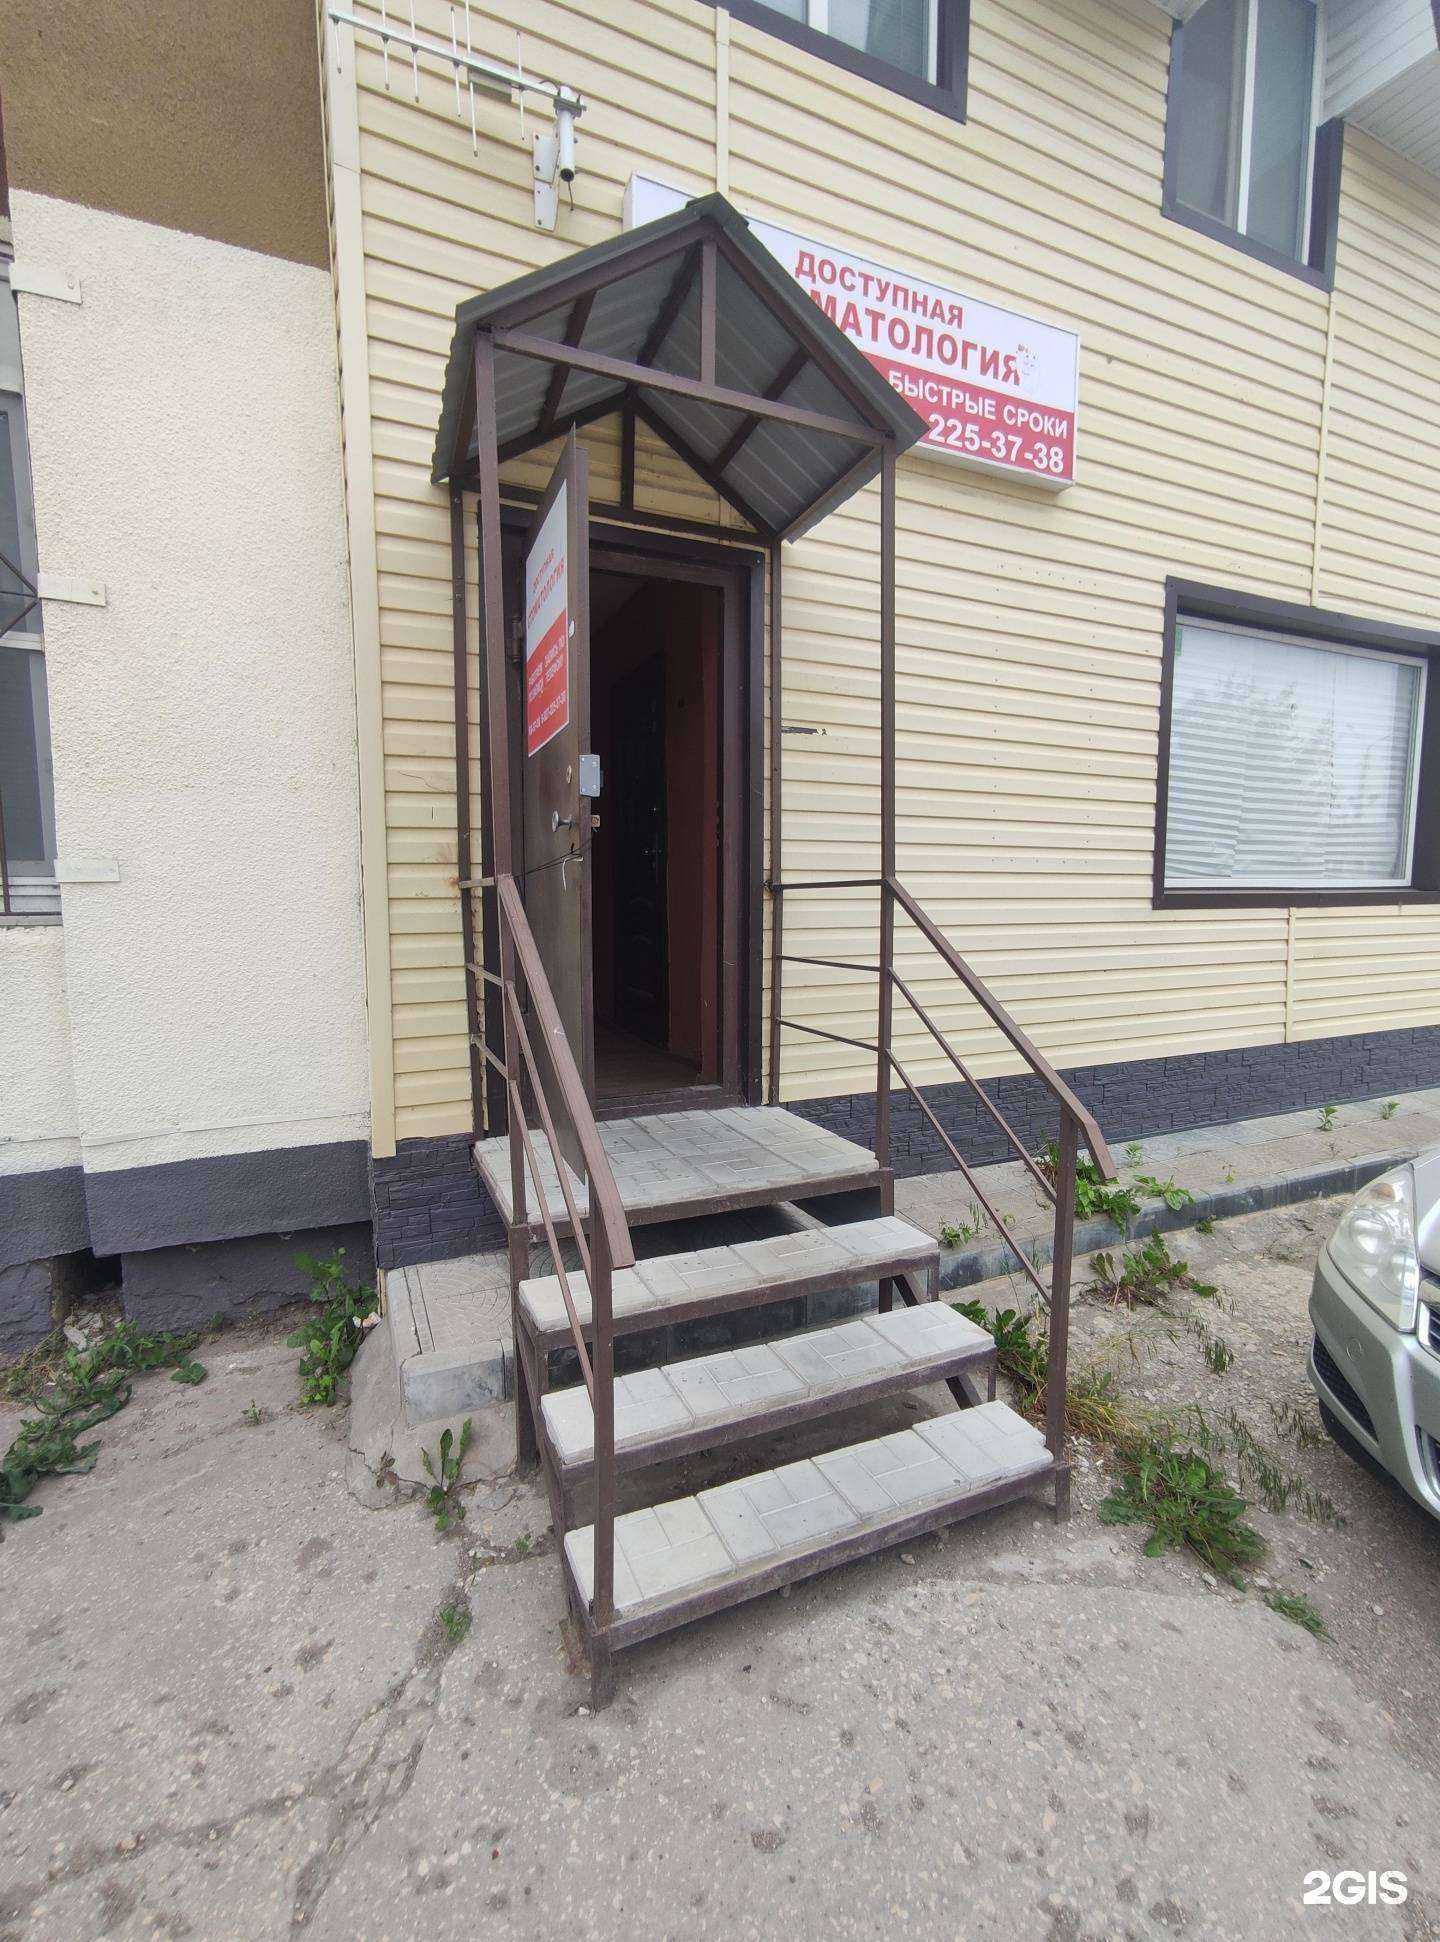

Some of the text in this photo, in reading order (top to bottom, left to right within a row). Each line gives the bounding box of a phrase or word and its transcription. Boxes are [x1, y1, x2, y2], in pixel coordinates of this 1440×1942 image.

[795, 250, 964, 330] ДОСТУПНАЯ
[888, 369, 1068, 440] БЫСТРЫЕ СРОКИ
[928, 413, 1065, 474] 225-37-38
